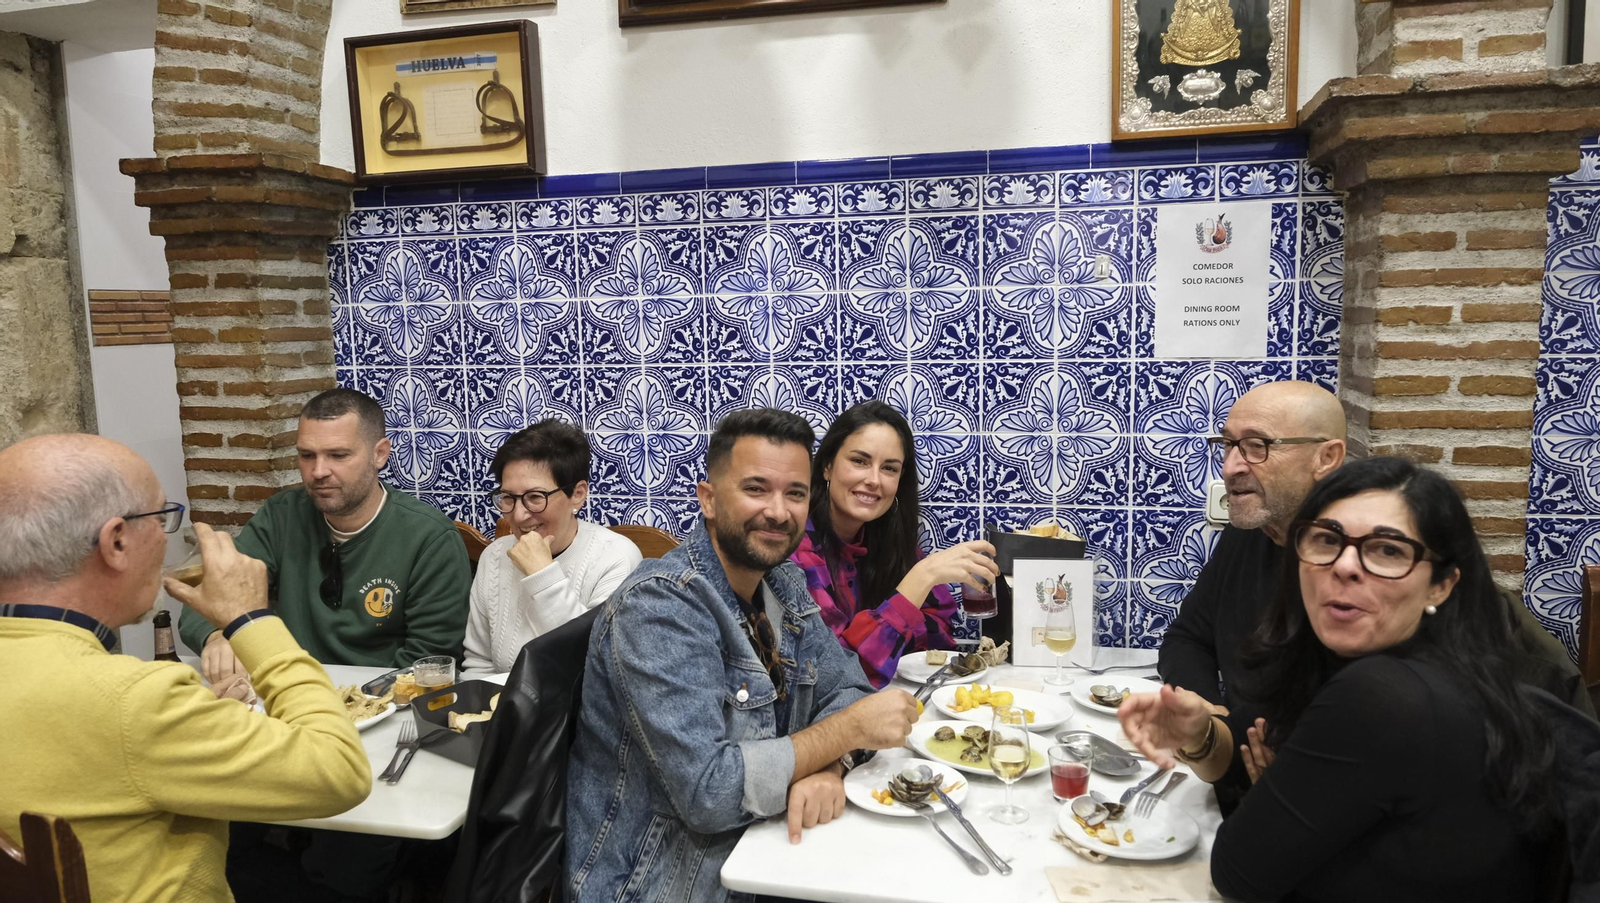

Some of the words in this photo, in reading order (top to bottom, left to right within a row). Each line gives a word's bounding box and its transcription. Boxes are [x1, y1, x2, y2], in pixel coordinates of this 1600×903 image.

[411, 56, 466, 73] HUELVA
[1182, 277, 1203, 285] SOLO
[1184, 305, 1213, 313] DINING
[1183, 319, 1217, 327] RATIONS
[1219, 319, 1241, 327] ONLY
[359, 578, 382, 594] DEATH
[385, 578, 401, 594] INSIDE
